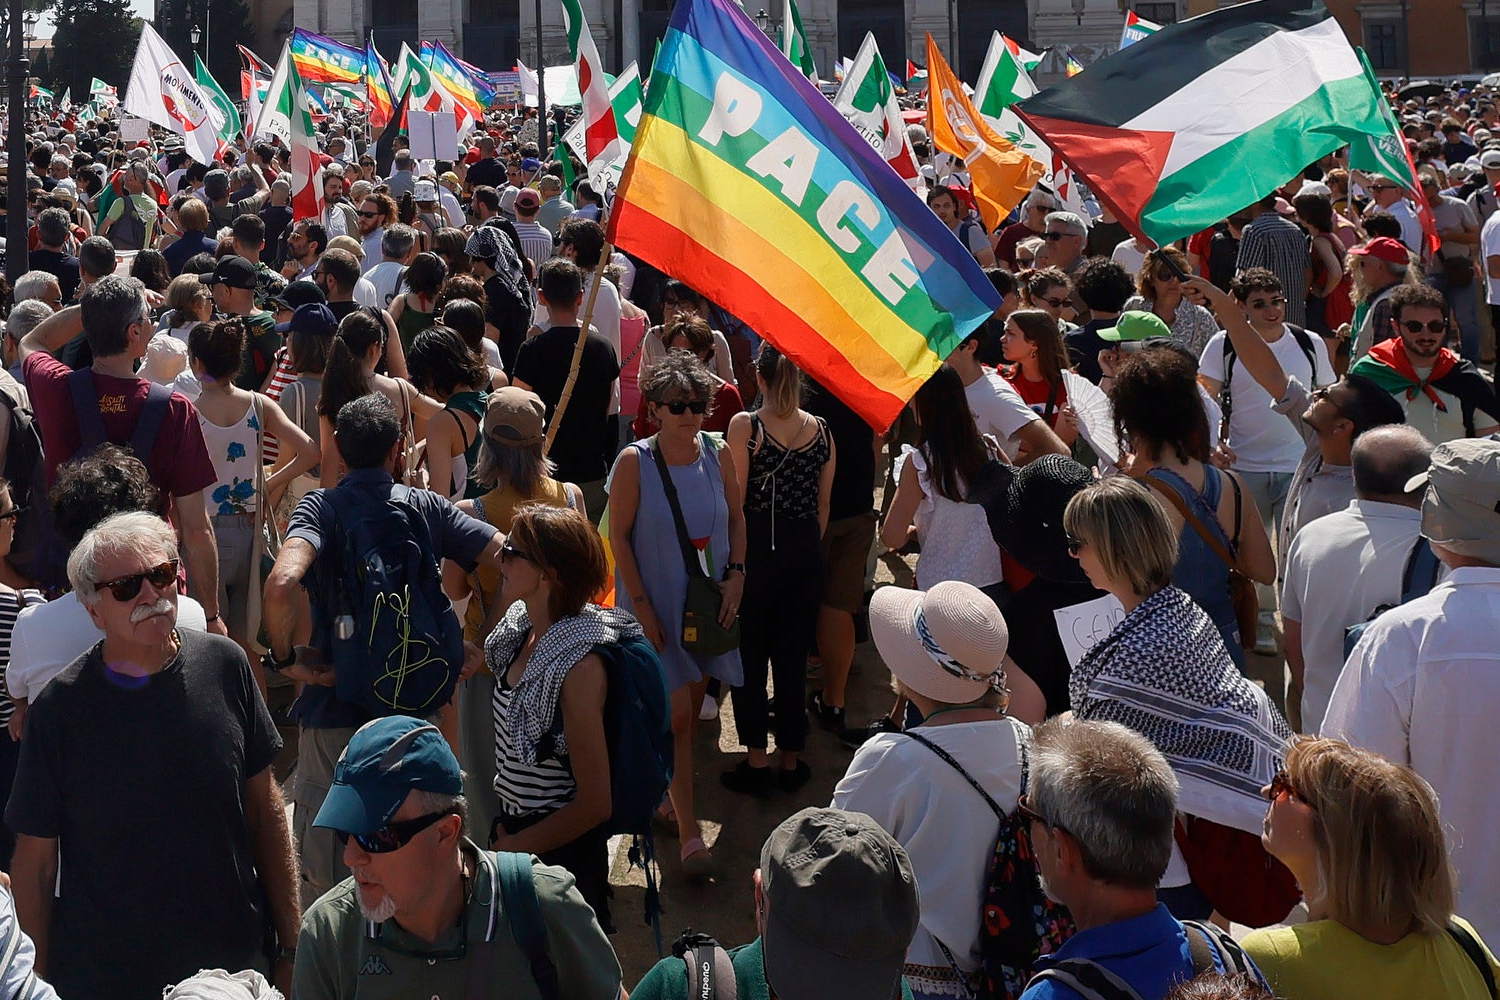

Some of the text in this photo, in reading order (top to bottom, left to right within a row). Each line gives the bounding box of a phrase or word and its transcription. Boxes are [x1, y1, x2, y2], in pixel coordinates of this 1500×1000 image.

[304, 43, 351, 70] PACE
[698, 71, 934, 306] PACE
[701, 961, 711, 1000] Quechu
